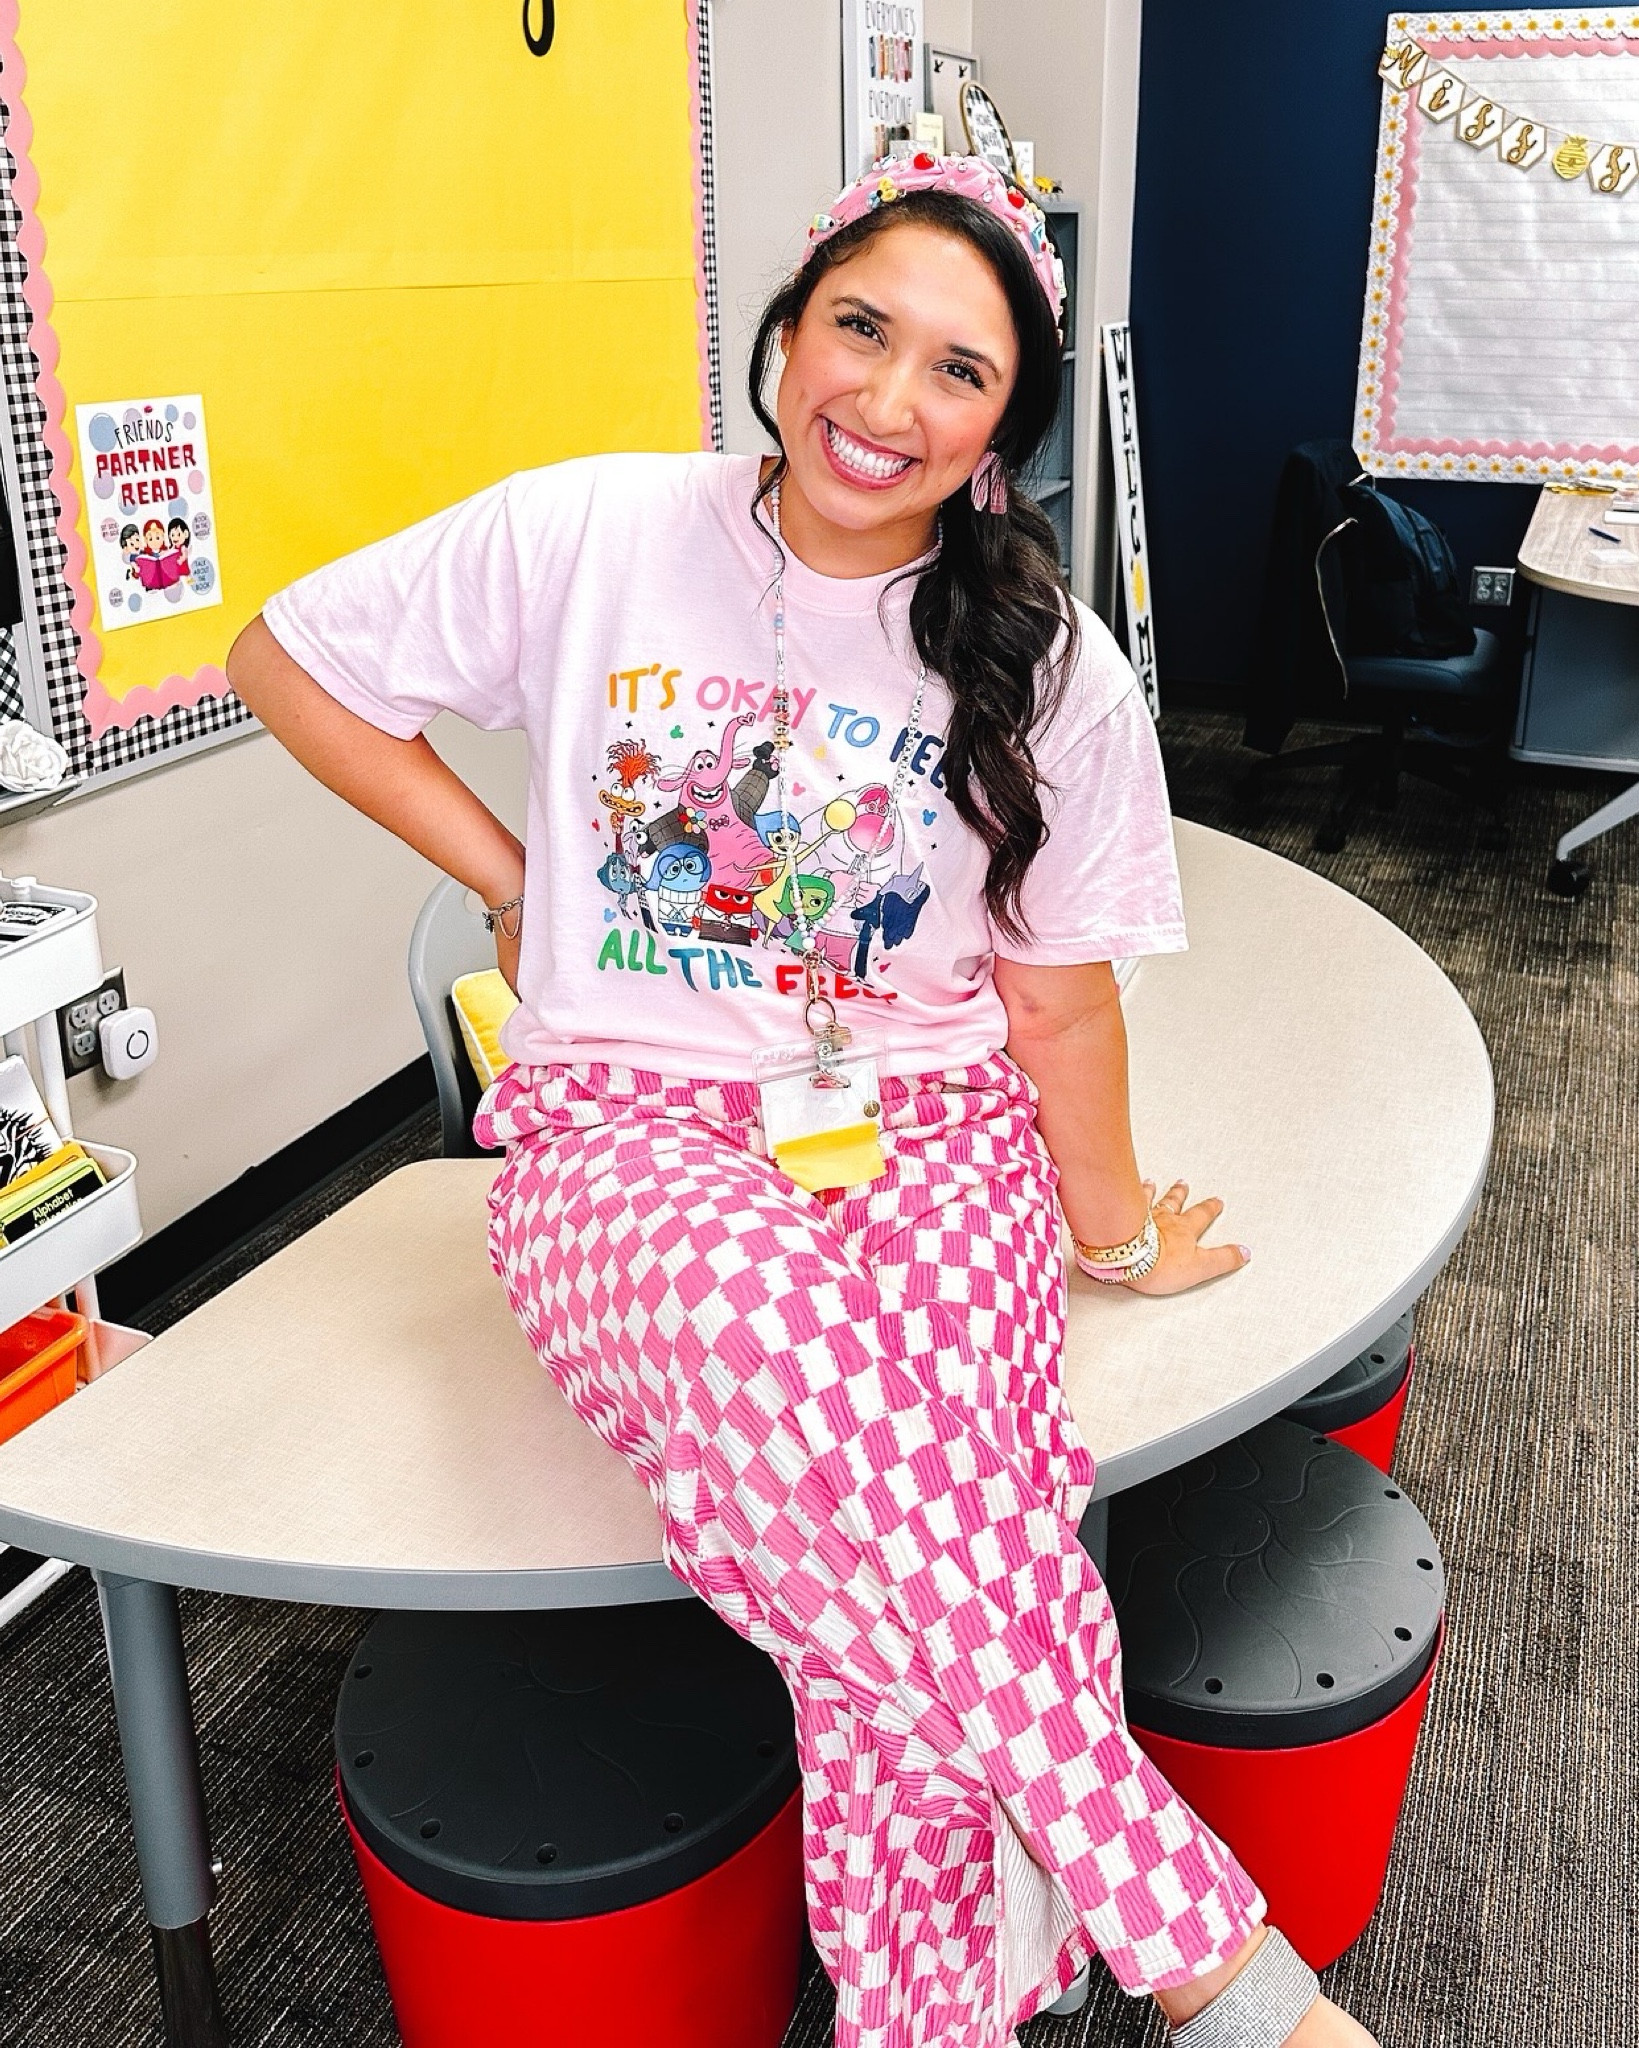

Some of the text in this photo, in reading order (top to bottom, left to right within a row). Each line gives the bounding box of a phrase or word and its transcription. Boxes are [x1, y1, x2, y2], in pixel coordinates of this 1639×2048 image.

[114, 419, 174, 449] FRIENDS
[96, 443, 197, 479] PARTNER
[121, 478, 180, 507] READ
[1110, 326, 1155, 718] WELCME
[609, 663, 682, 713] IT'S
[828, 703, 880, 748] TO
[598, 928, 668, 975] ALL
[668, 948, 763, 992] THE
[32, 1188, 74, 1219] Alphabet
